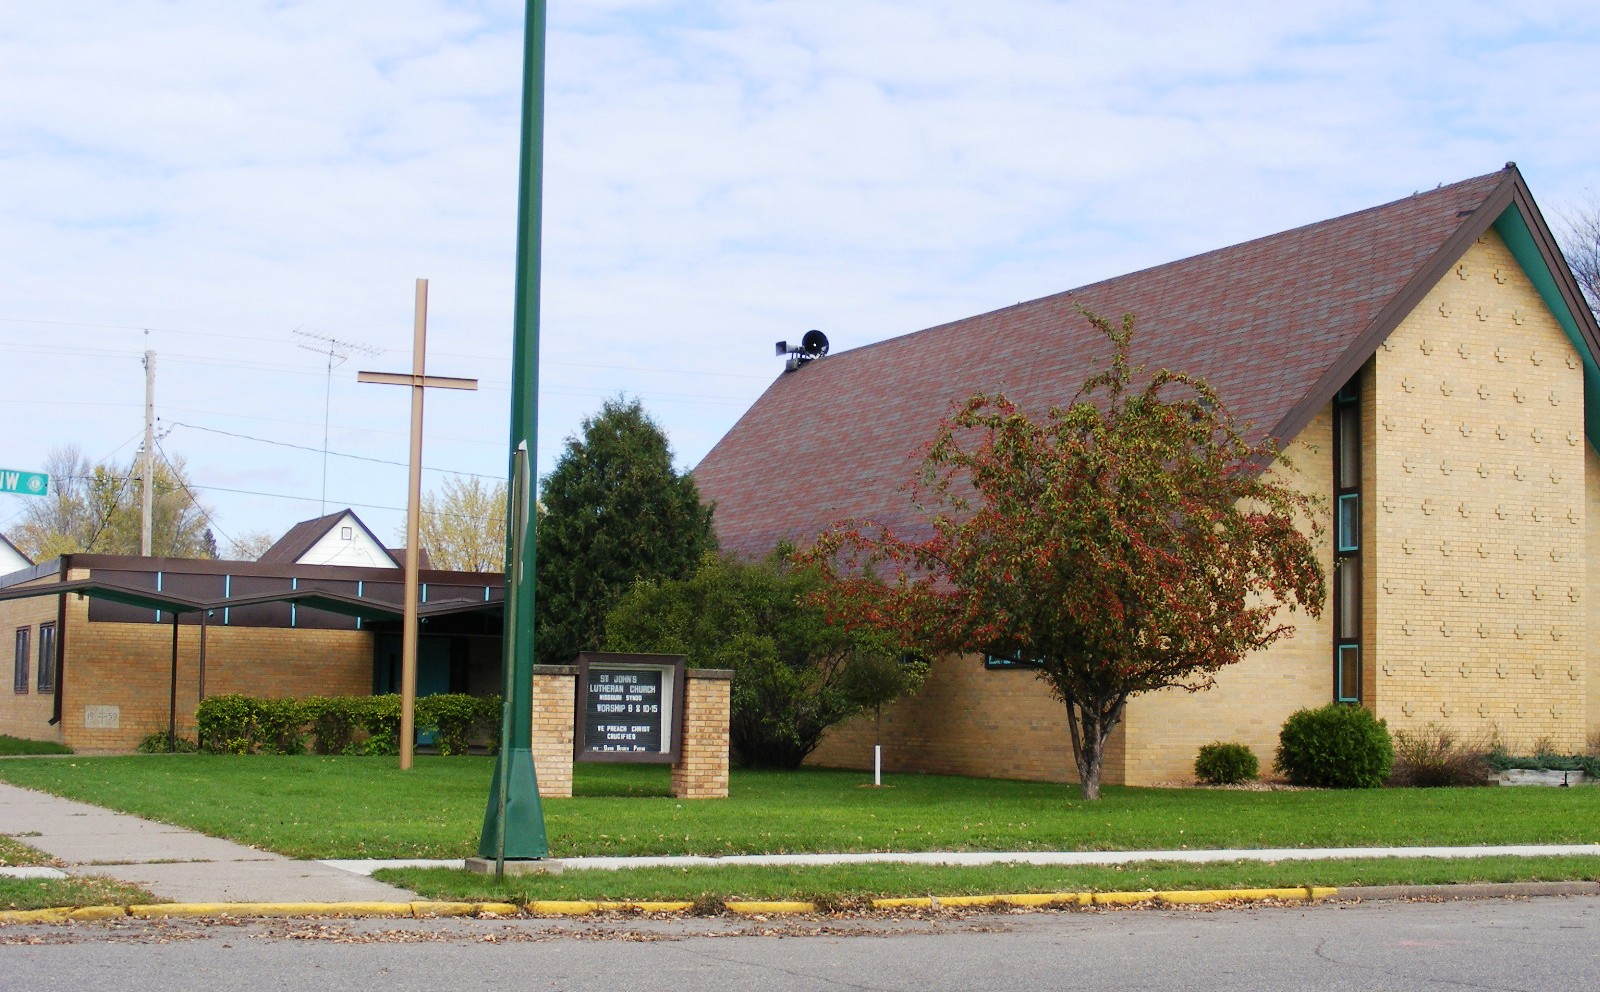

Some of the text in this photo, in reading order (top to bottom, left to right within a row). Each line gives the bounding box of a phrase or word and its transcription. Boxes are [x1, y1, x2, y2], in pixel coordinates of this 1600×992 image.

[600, 674, 609, 683] ST
[589, 684, 656, 694] LUTHERAN CHURCH
[596, 704, 625, 712] WORSHIP
[628, 704, 633, 713] 8
